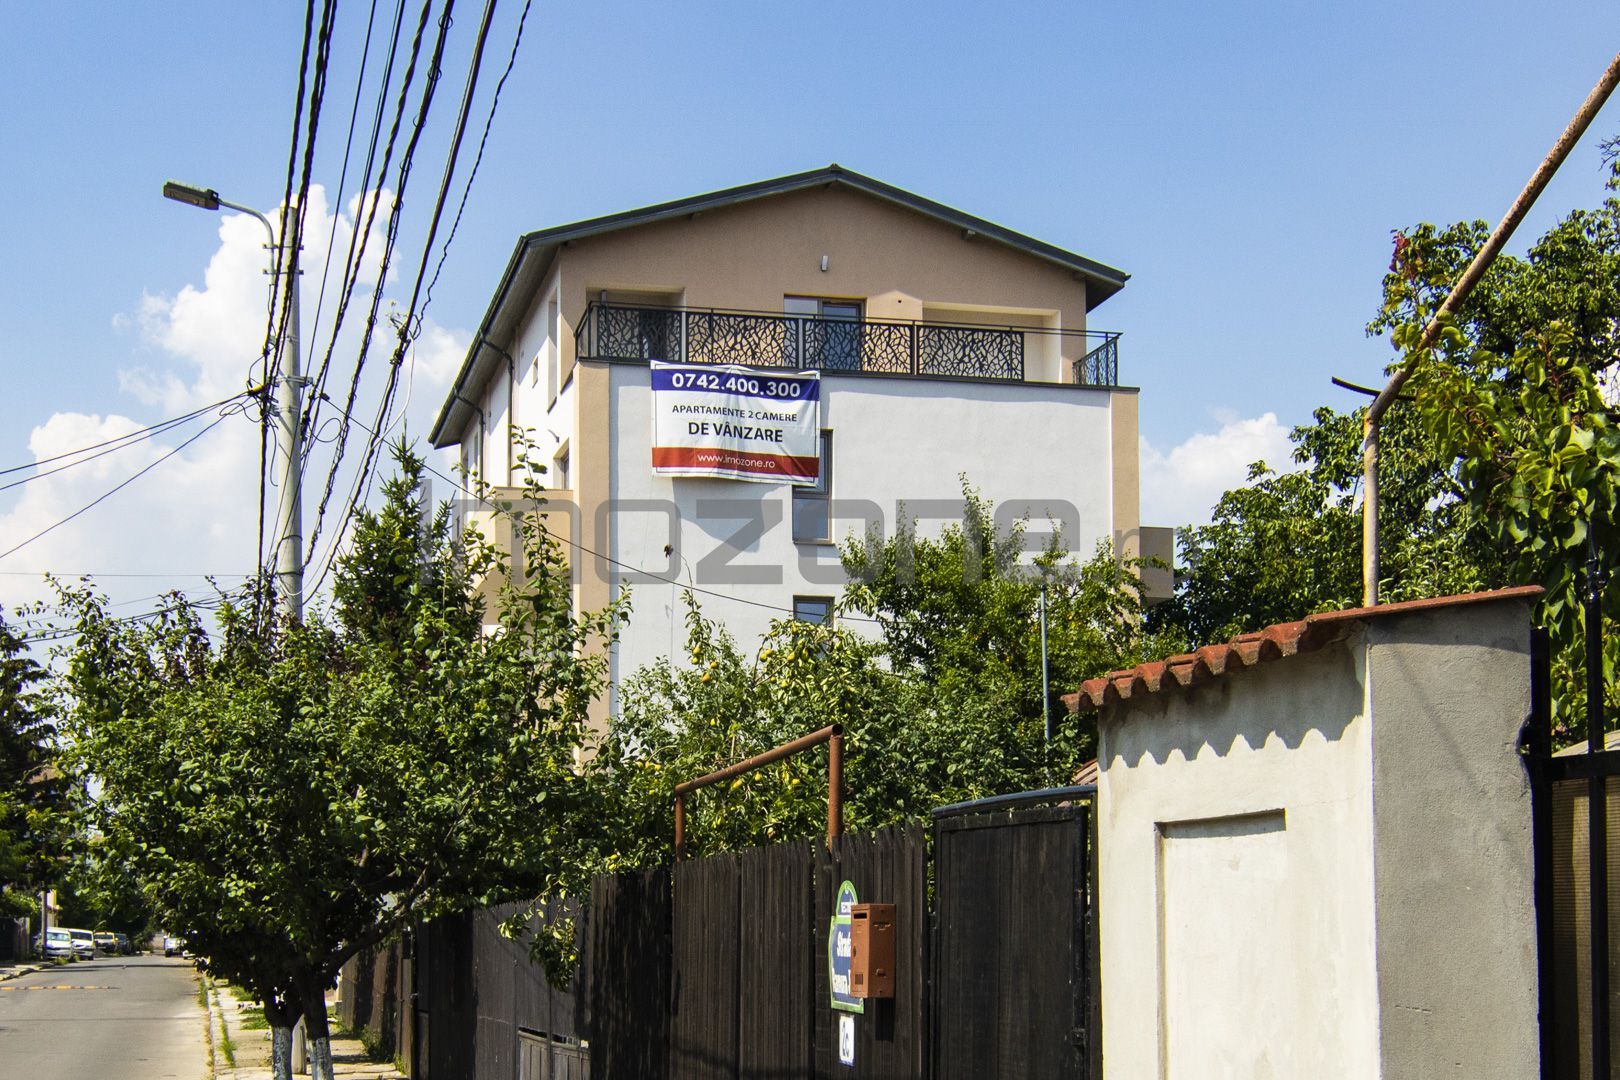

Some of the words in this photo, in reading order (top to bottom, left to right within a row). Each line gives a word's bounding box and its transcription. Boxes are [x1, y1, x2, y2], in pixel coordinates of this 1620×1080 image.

[672, 373, 801, 397] 0742.400.300
[672, 405, 745, 418] APARTAMENTE
[755, 411, 798, 422] CAMERE
[688, 422, 709, 435] DE
[713, 422, 784, 442] VÂNZARE
[697, 454, 776, 469] www.imozone.ro
